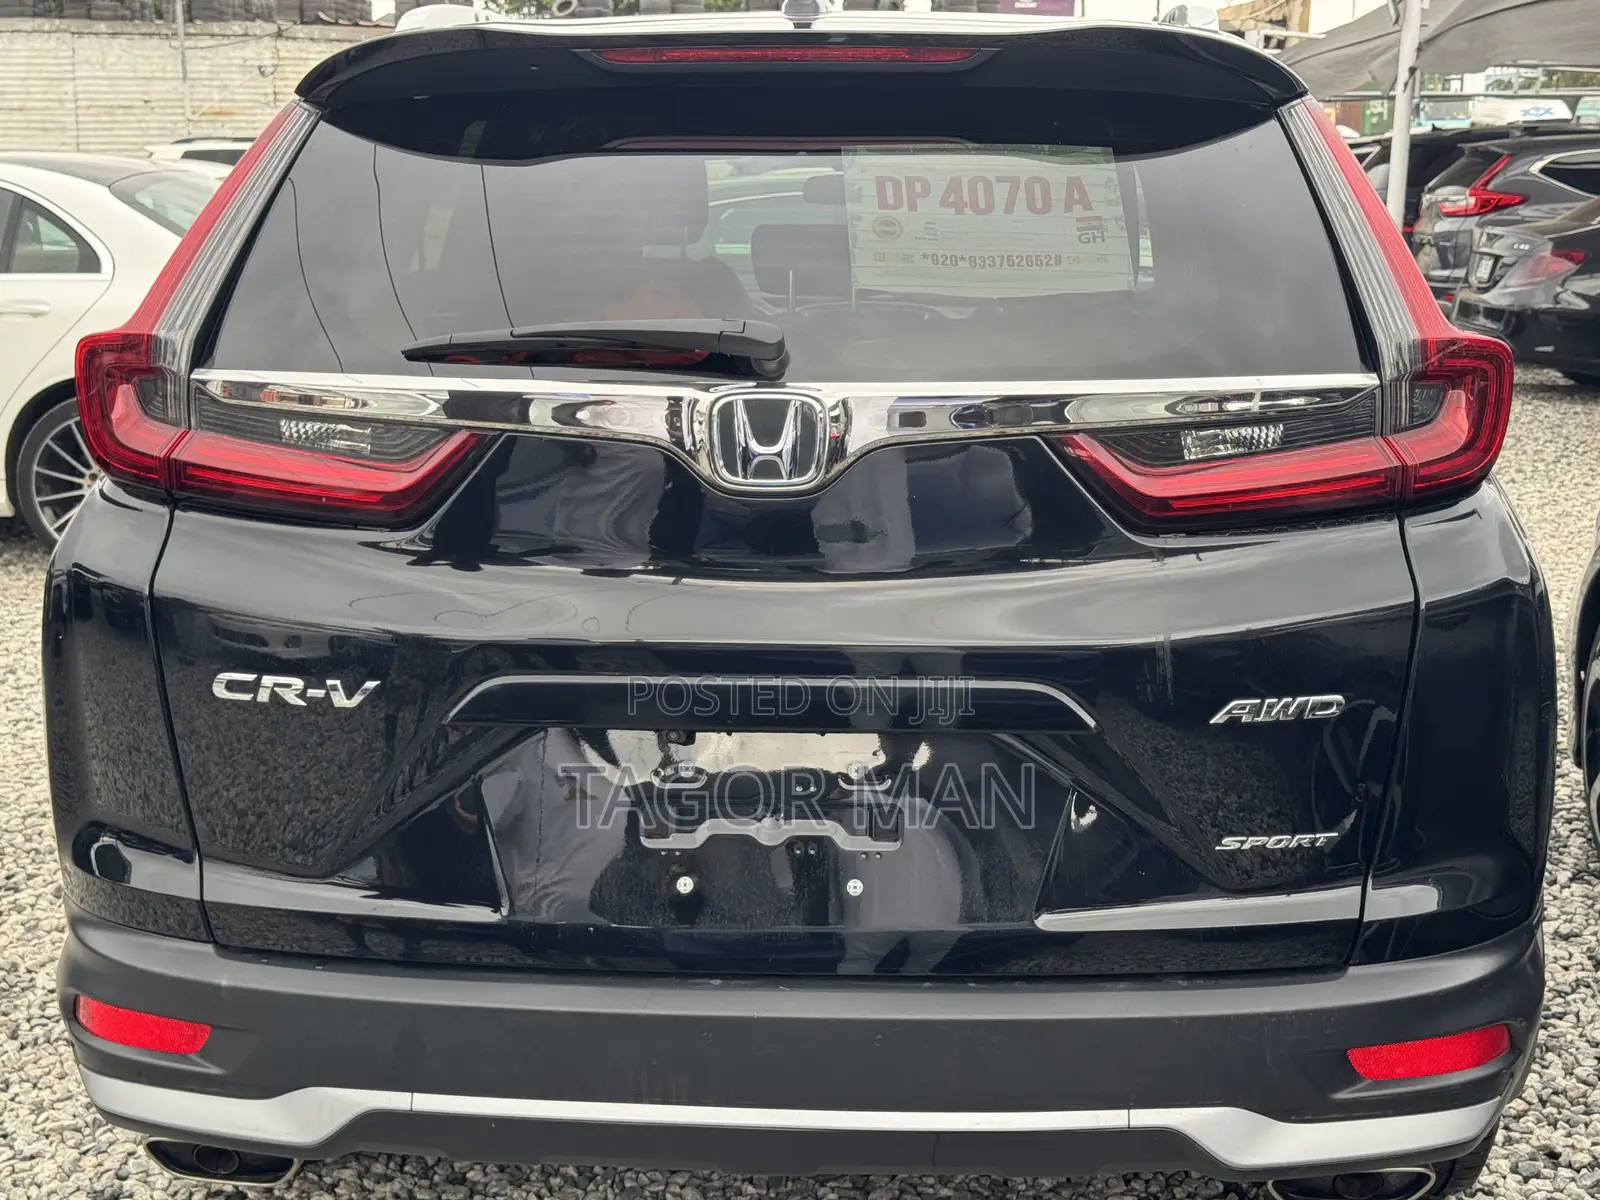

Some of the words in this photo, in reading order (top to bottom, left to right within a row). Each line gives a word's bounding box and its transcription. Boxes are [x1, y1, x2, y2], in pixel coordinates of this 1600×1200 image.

[874, 175, 931, 213] DP
[938, 175, 1052, 216] 4070
[1063, 175, 1095, 213] A
[1077, 231, 1106, 245] GH
[211, 671, 382, 709] CR-V
[1209, 694, 1346, 724] AWD
[1214, 832, 1339, 851] SPORT
